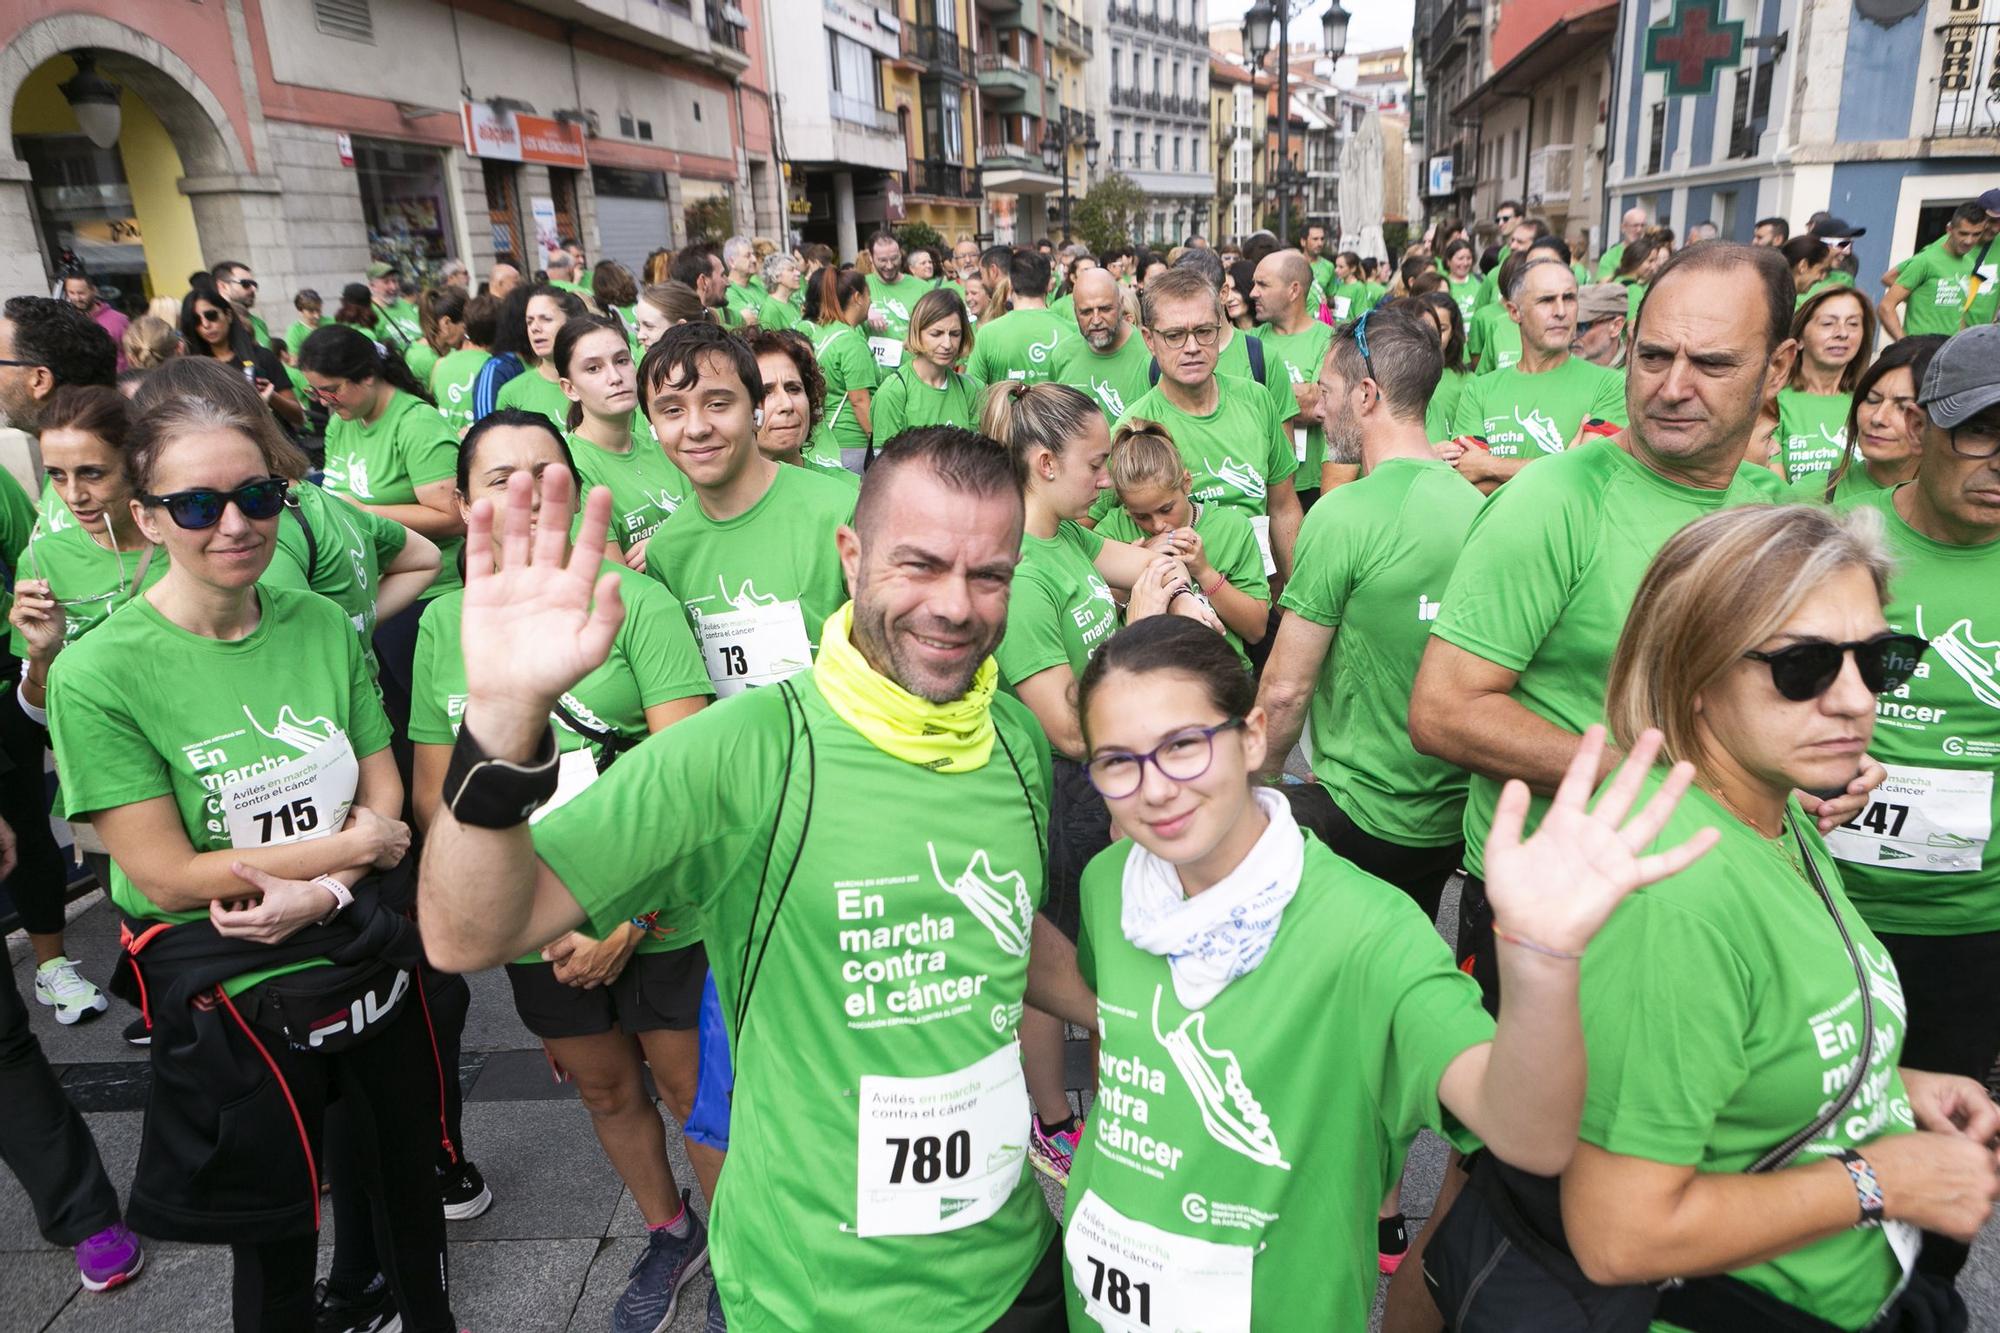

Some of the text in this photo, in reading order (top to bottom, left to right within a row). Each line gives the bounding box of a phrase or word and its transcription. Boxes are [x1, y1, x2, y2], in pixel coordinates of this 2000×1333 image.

[1789, 438, 1807, 449] En
[1789, 447, 1838, 460] marcha
[1789, 460, 1832, 472] contra
[625, 514, 645, 530] En
[705, 629, 724, 640] contra
[1073, 609, 1095, 628] En
[719, 645, 748, 676] 73
[186, 747, 228, 771] En
[232, 761, 318, 801] Avilés en marcha
[234, 793, 271, 810] contra
[271, 786, 284, 800] el
[284, 773, 318, 793] cáncer
[1886, 783, 1926, 797] cáncer
[1888, 775, 1932, 787] marcha
[253, 796, 319, 844] 715
[837, 888, 885, 920] En
[839, 913, 955, 953] marcha
[842, 948, 946, 983] contra
[309, 969, 409, 1047] FILA
[844, 974, 988, 1017] el cáncer
[1811, 1020, 1857, 1060] En
[871, 1097, 978, 1119] contra el cáncer
[872, 1092, 915, 1105] Avilés
[919, 1095, 937, 1104] en
[940, 1081, 982, 1103] marcha
[886, 1129, 971, 1184] 780
[1098, 1117, 1184, 1171] cáncer
[1076, 1221, 1107, 1247] contra
[1108, 1240, 1121, 1255] el
[1121, 1246, 1164, 1272] cáncer
[1087, 1255, 1151, 1327] 781
